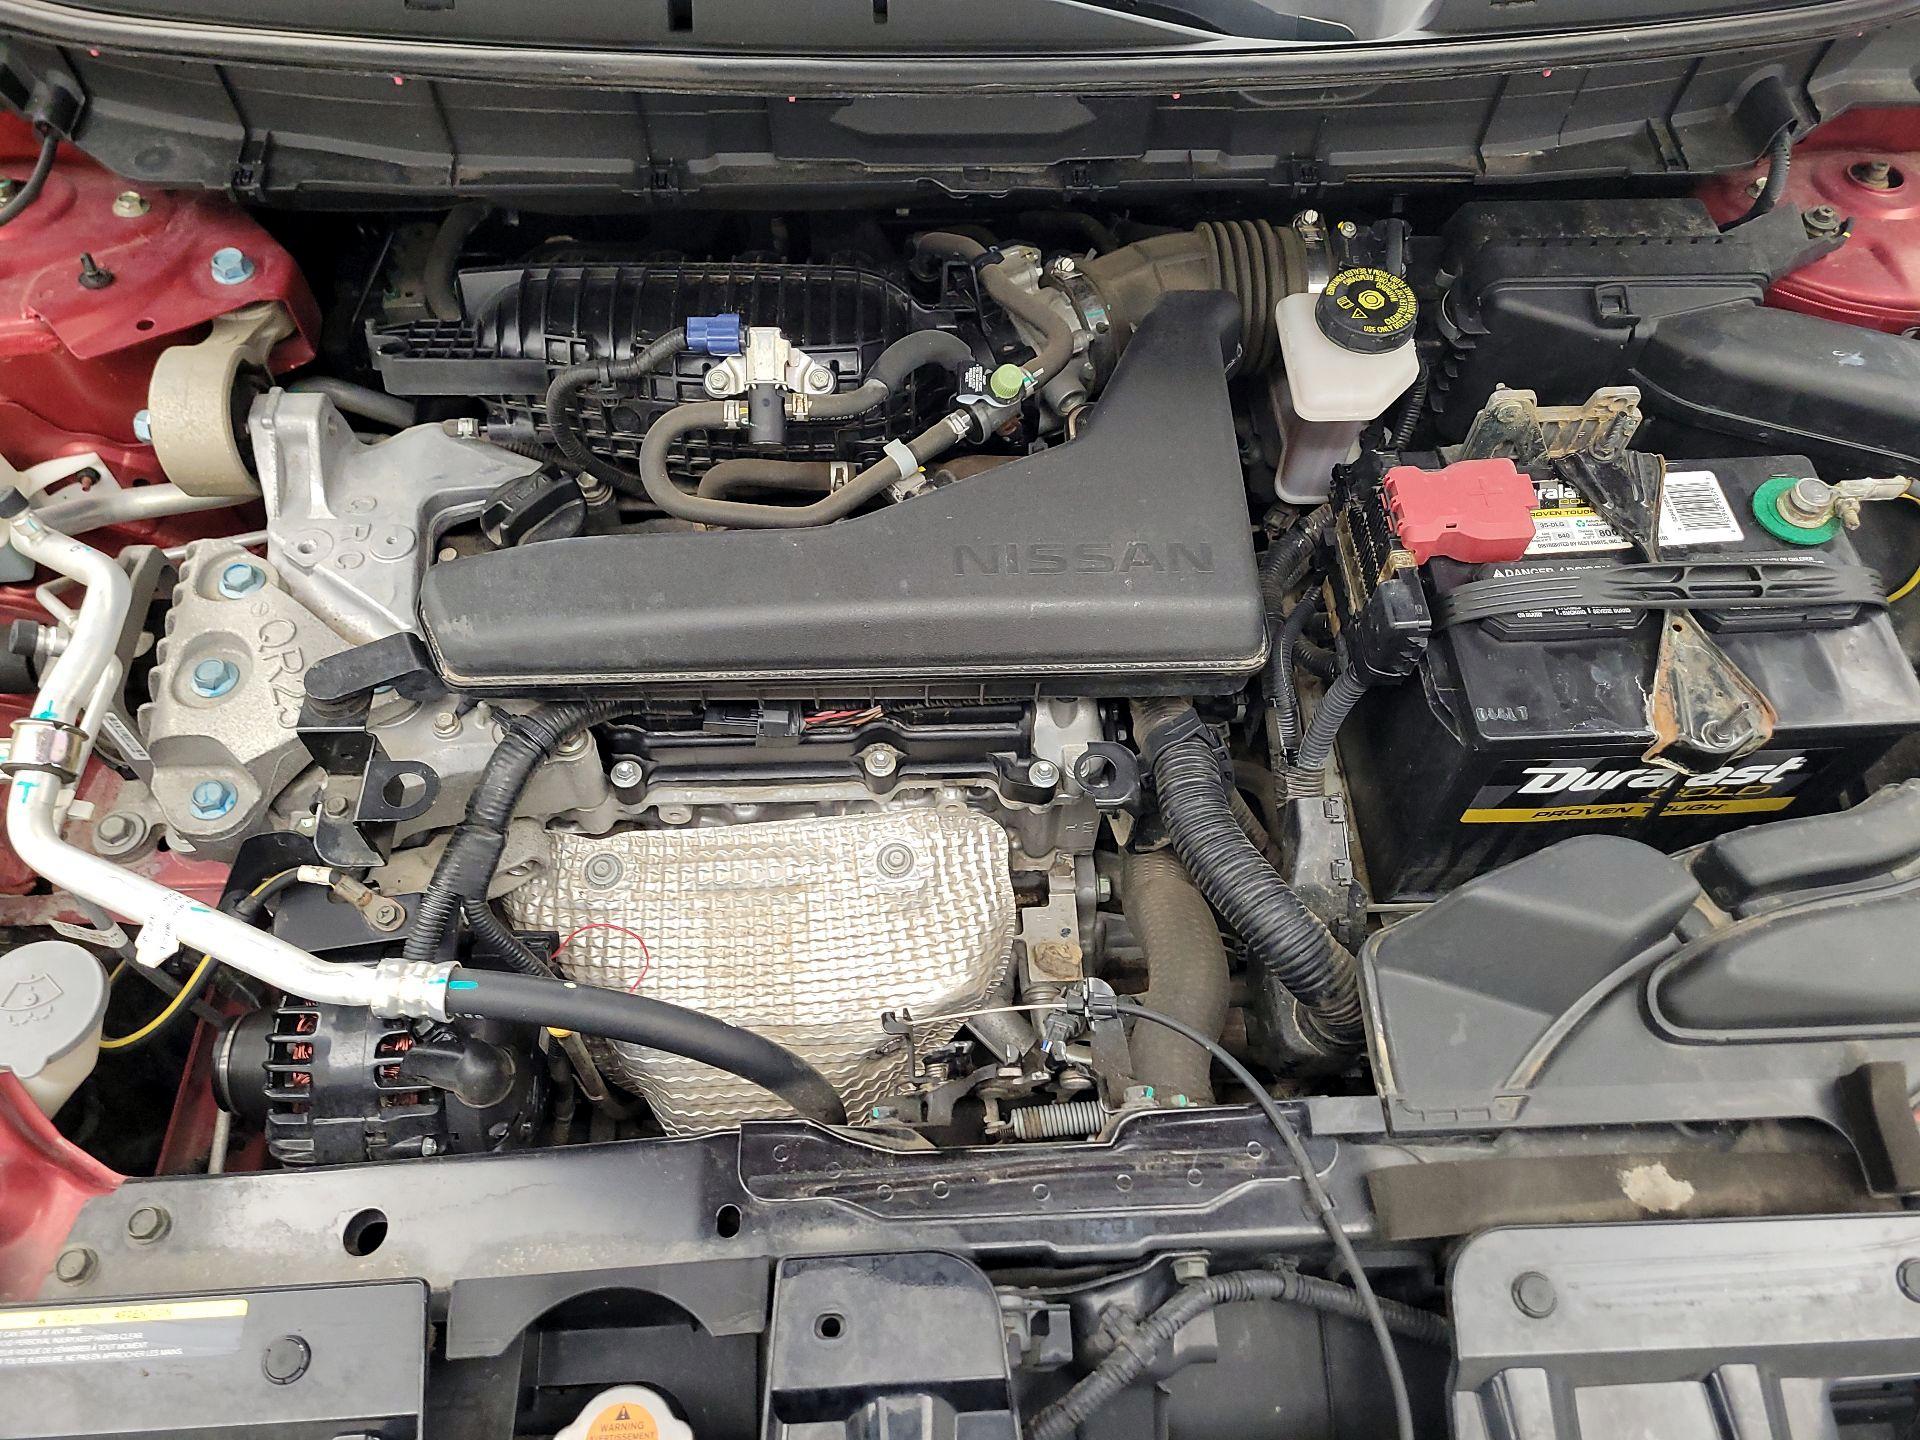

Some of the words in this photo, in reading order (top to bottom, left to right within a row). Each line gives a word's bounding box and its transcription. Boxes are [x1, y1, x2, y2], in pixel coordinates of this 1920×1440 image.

[1343, 268, 1366, 278] SEALED
[1343, 271, 1374, 284] REMOVING
[1372, 269, 1390, 278] FROM
[1374, 275, 1398, 289] BEFORE
[1390, 275, 1405, 287] FLUID
[1363, 325, 1376, 333] USE
[1377, 322, 1392, 332] ONLY
[953, 541, 1215, 576] NISSAN
[1531, 805, 1635, 820] PROVEN
[600, 1421, 645, 1432] WARNING
